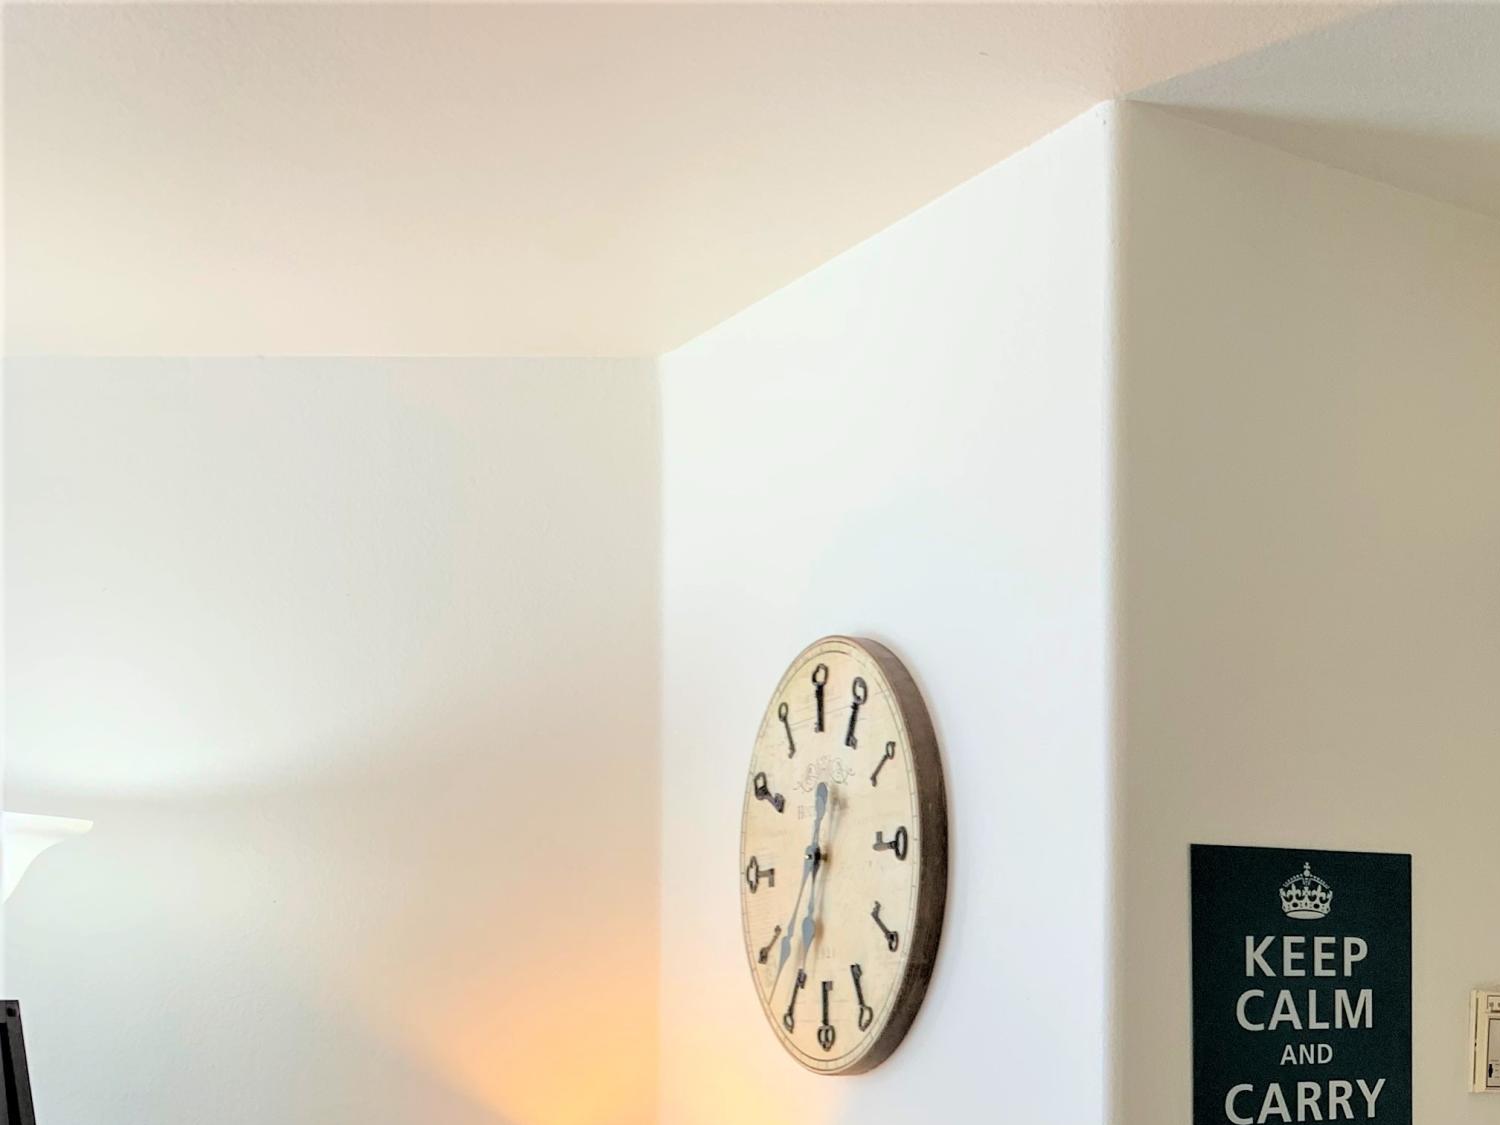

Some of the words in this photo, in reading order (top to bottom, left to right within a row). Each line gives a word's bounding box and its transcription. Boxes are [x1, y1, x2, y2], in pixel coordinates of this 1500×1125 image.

[1244, 935, 1368, 977] KEEP
[1236, 988, 1373, 1031] CALM
[1280, 1043, 1333, 1066] AND
[1224, 1078, 1386, 1125] CARRY
